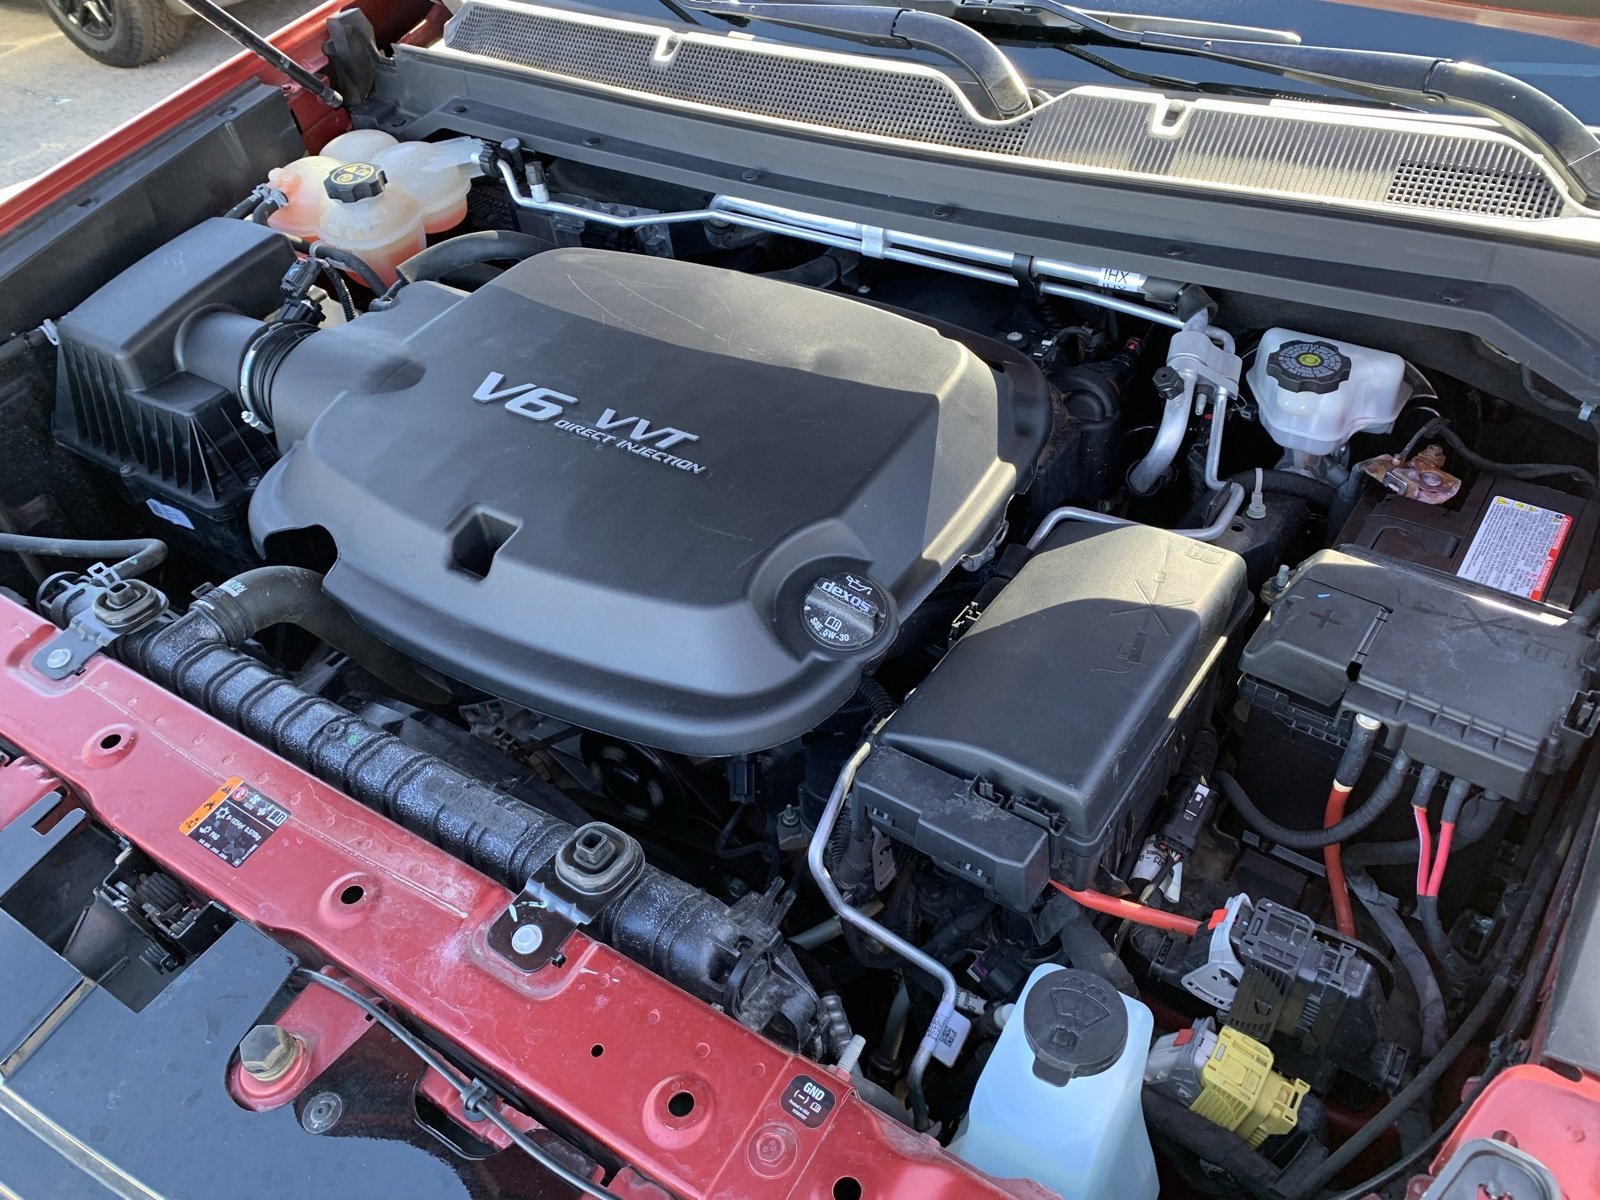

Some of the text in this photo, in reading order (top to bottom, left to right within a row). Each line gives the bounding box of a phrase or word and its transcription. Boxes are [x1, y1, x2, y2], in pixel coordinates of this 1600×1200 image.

[1104, 268, 1129, 283] IHX
[472, 371, 579, 421] V6
[595, 408, 699, 450] VVT
[553, 419, 706, 474] DIRECT INJECTION
[821, 582, 870, 612] dexos
[810, 617, 850, 641] SAE 5W-30
[803, 1082, 825, 1101] GND
